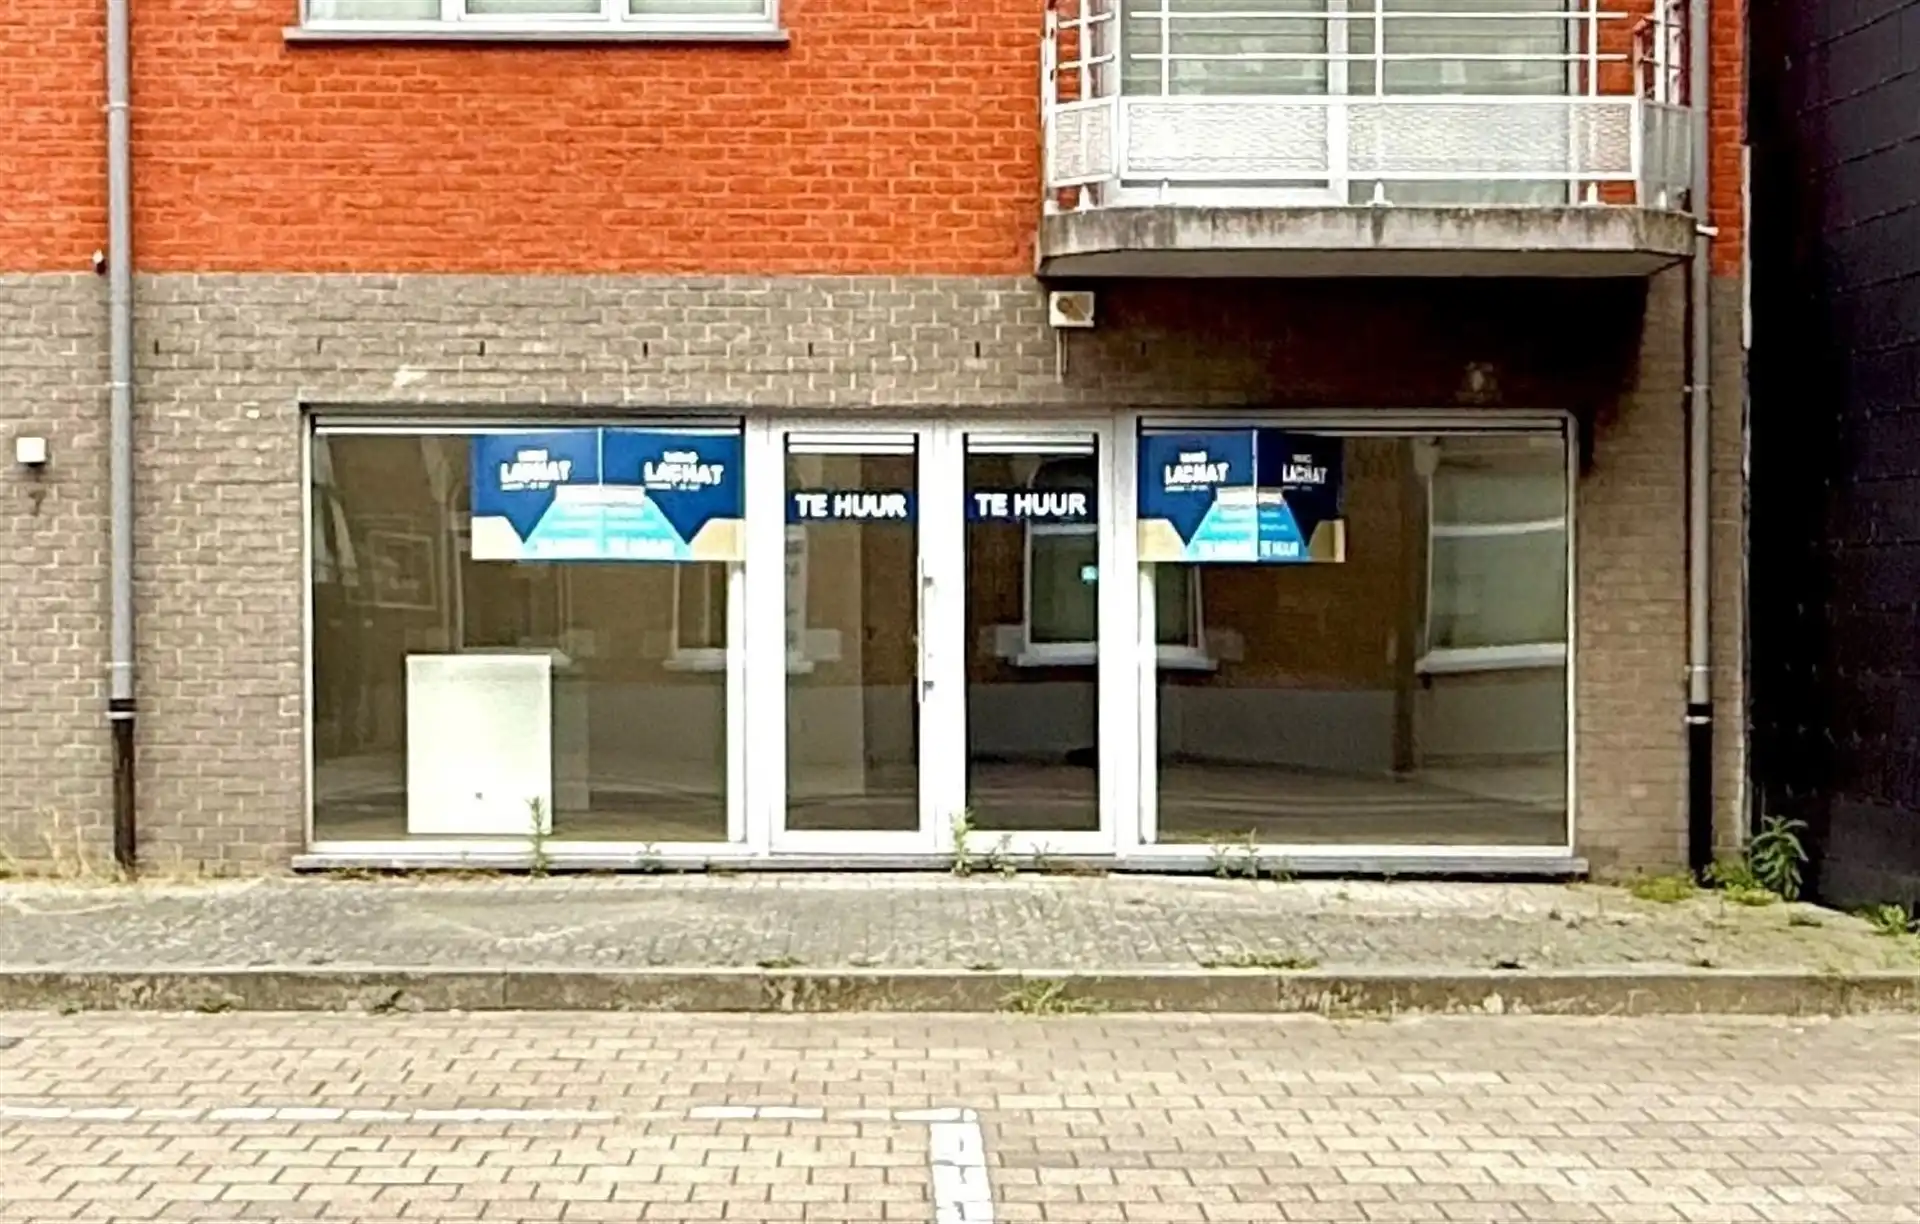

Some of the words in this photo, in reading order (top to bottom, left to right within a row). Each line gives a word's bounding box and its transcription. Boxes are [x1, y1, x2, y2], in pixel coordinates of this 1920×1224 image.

[795, 492, 828, 517] TE
[833, 492, 908, 518] HUUR
[974, 492, 1009, 517] TE
[1013, 492, 1088, 517] HUUR
